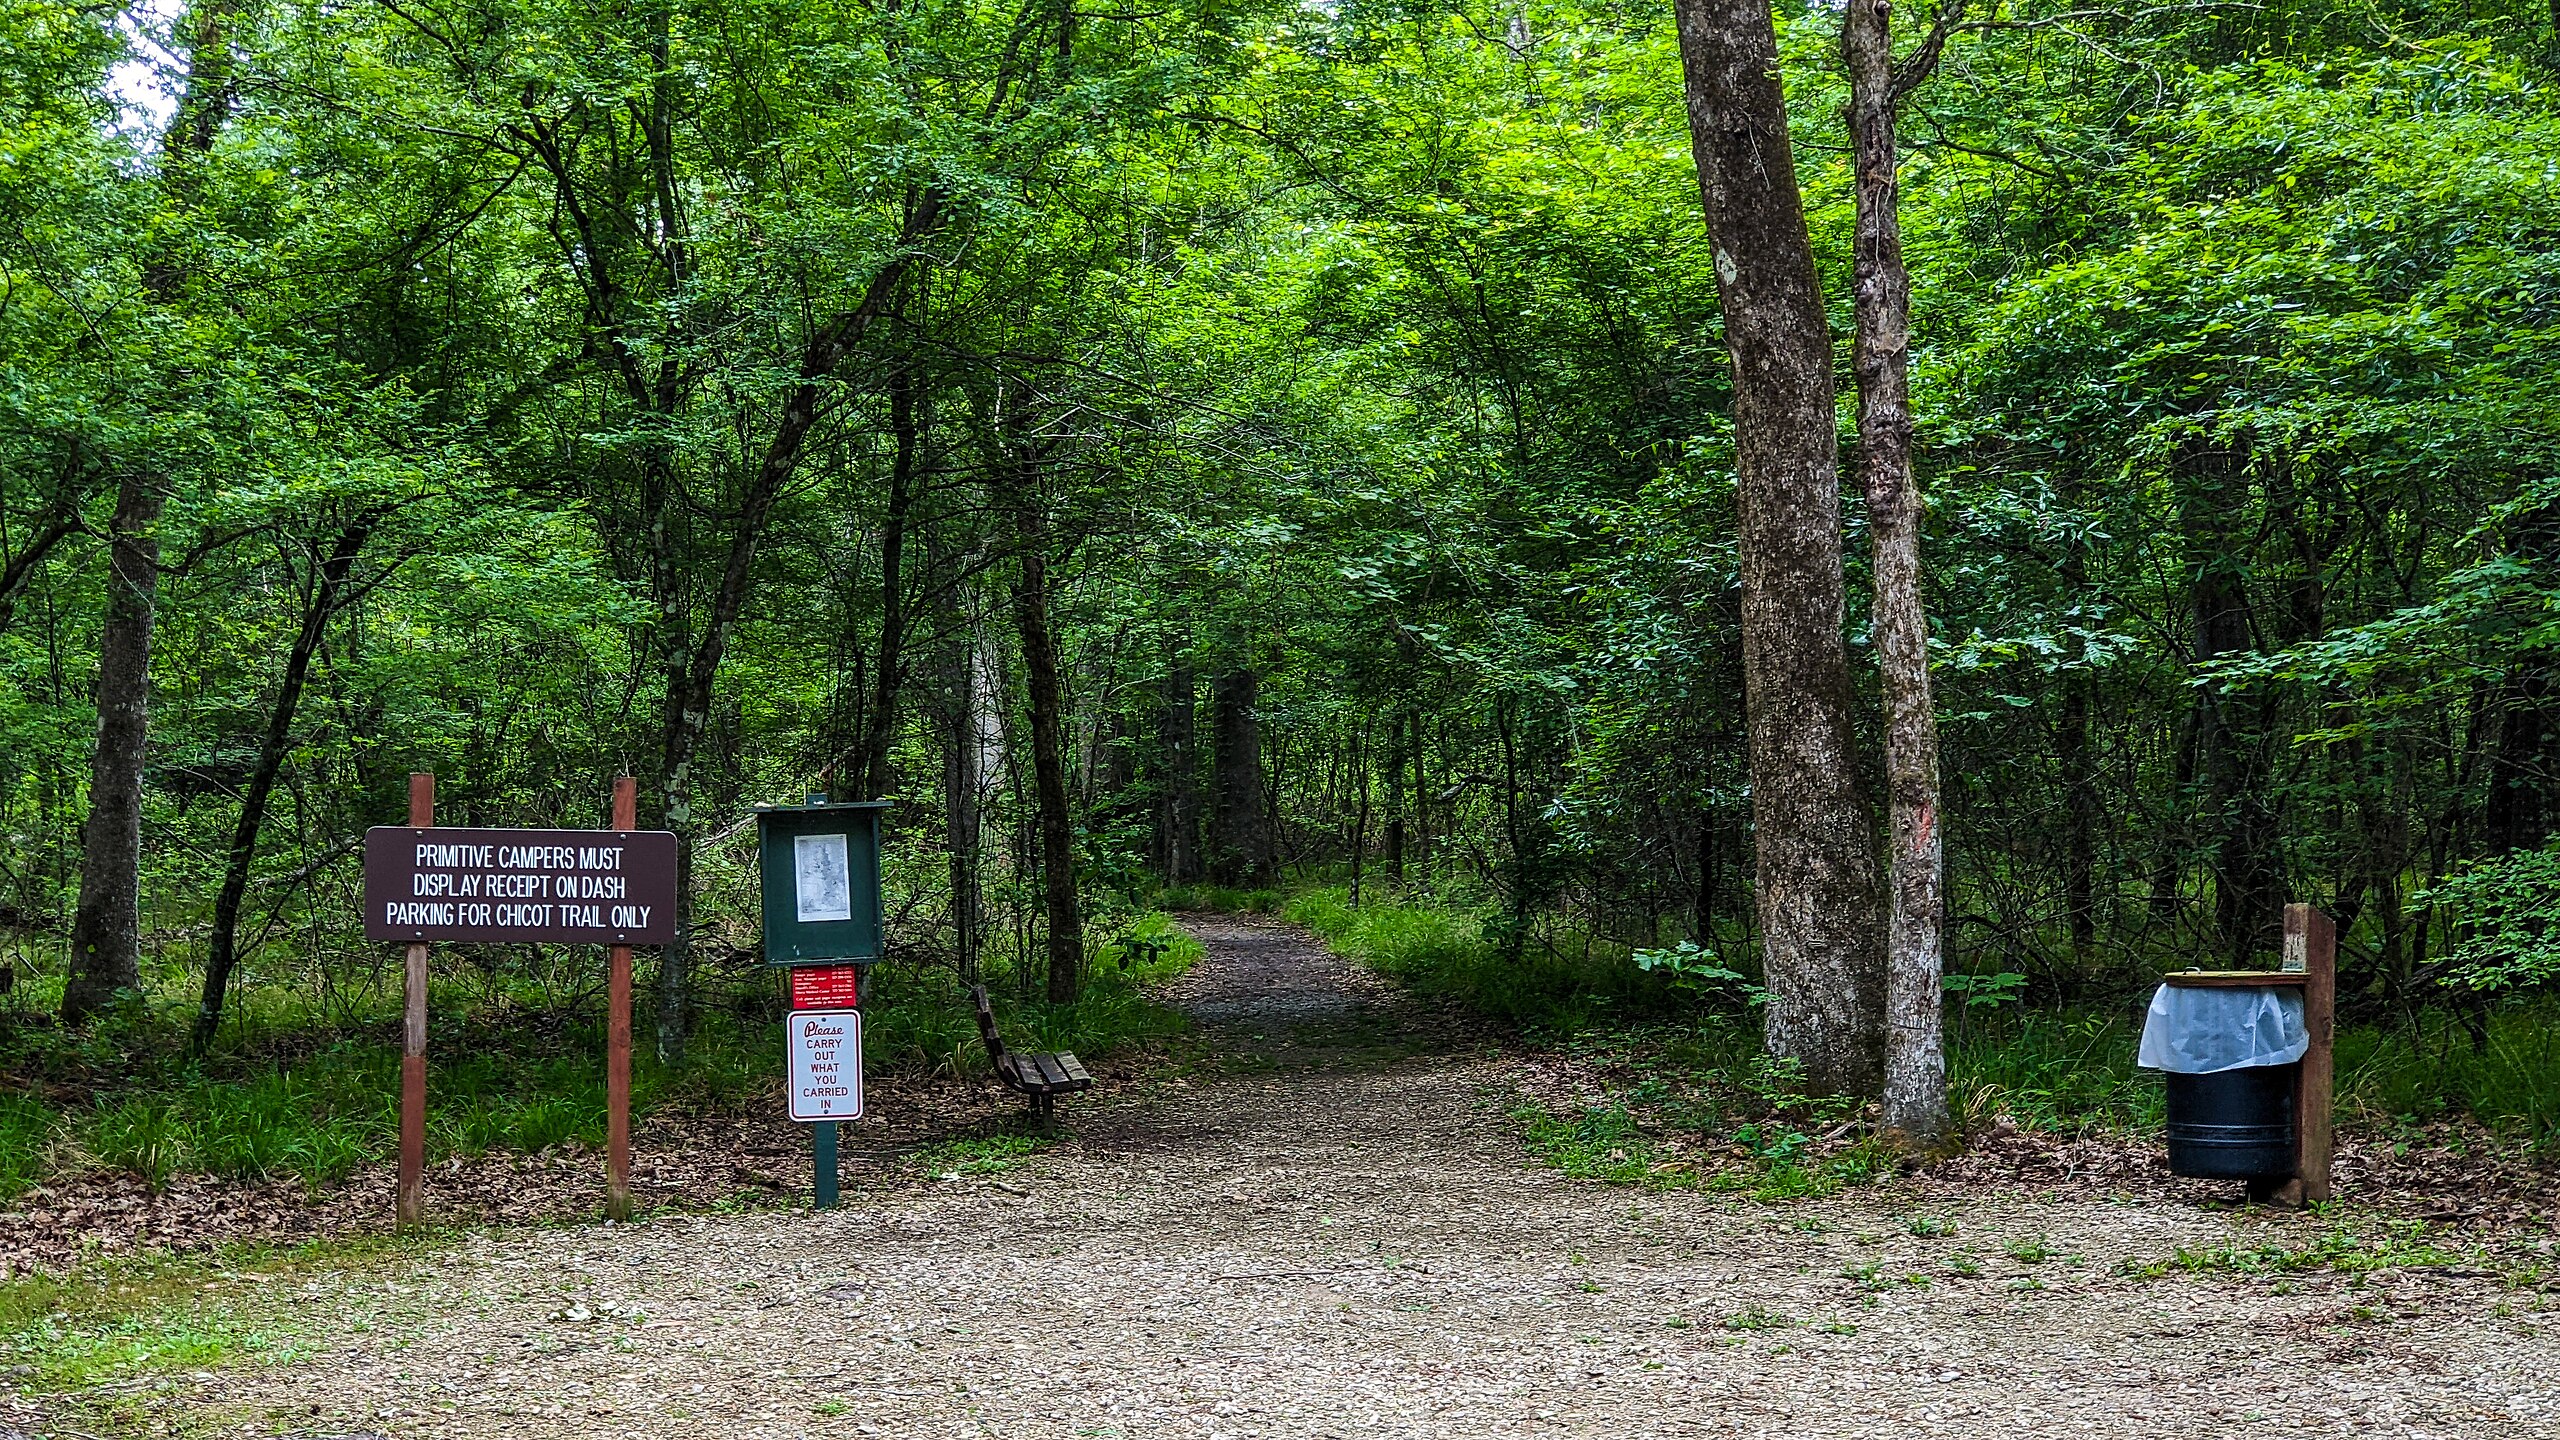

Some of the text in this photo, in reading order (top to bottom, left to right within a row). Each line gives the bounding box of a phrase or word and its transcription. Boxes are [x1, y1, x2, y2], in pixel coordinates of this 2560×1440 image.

[417, 844, 623, 870] PRIMITIVE CAMPERS MUST
[414, 873, 625, 898] DISPLAY RECEIPT ON DASH
[387, 902, 650, 928] PARKING FOR CHICOT TRAIL ONLY
[805, 1021, 844, 1037] Please
[807, 1039, 842, 1048] CARRY
[815, 1051, 835, 1060] OUT
[811, 1063, 839, 1072] WHAT
[815, 1076, 836, 1084] YOU
[804, 1087, 848, 1097] CARRIED
[821, 1100, 830, 1108] IN
